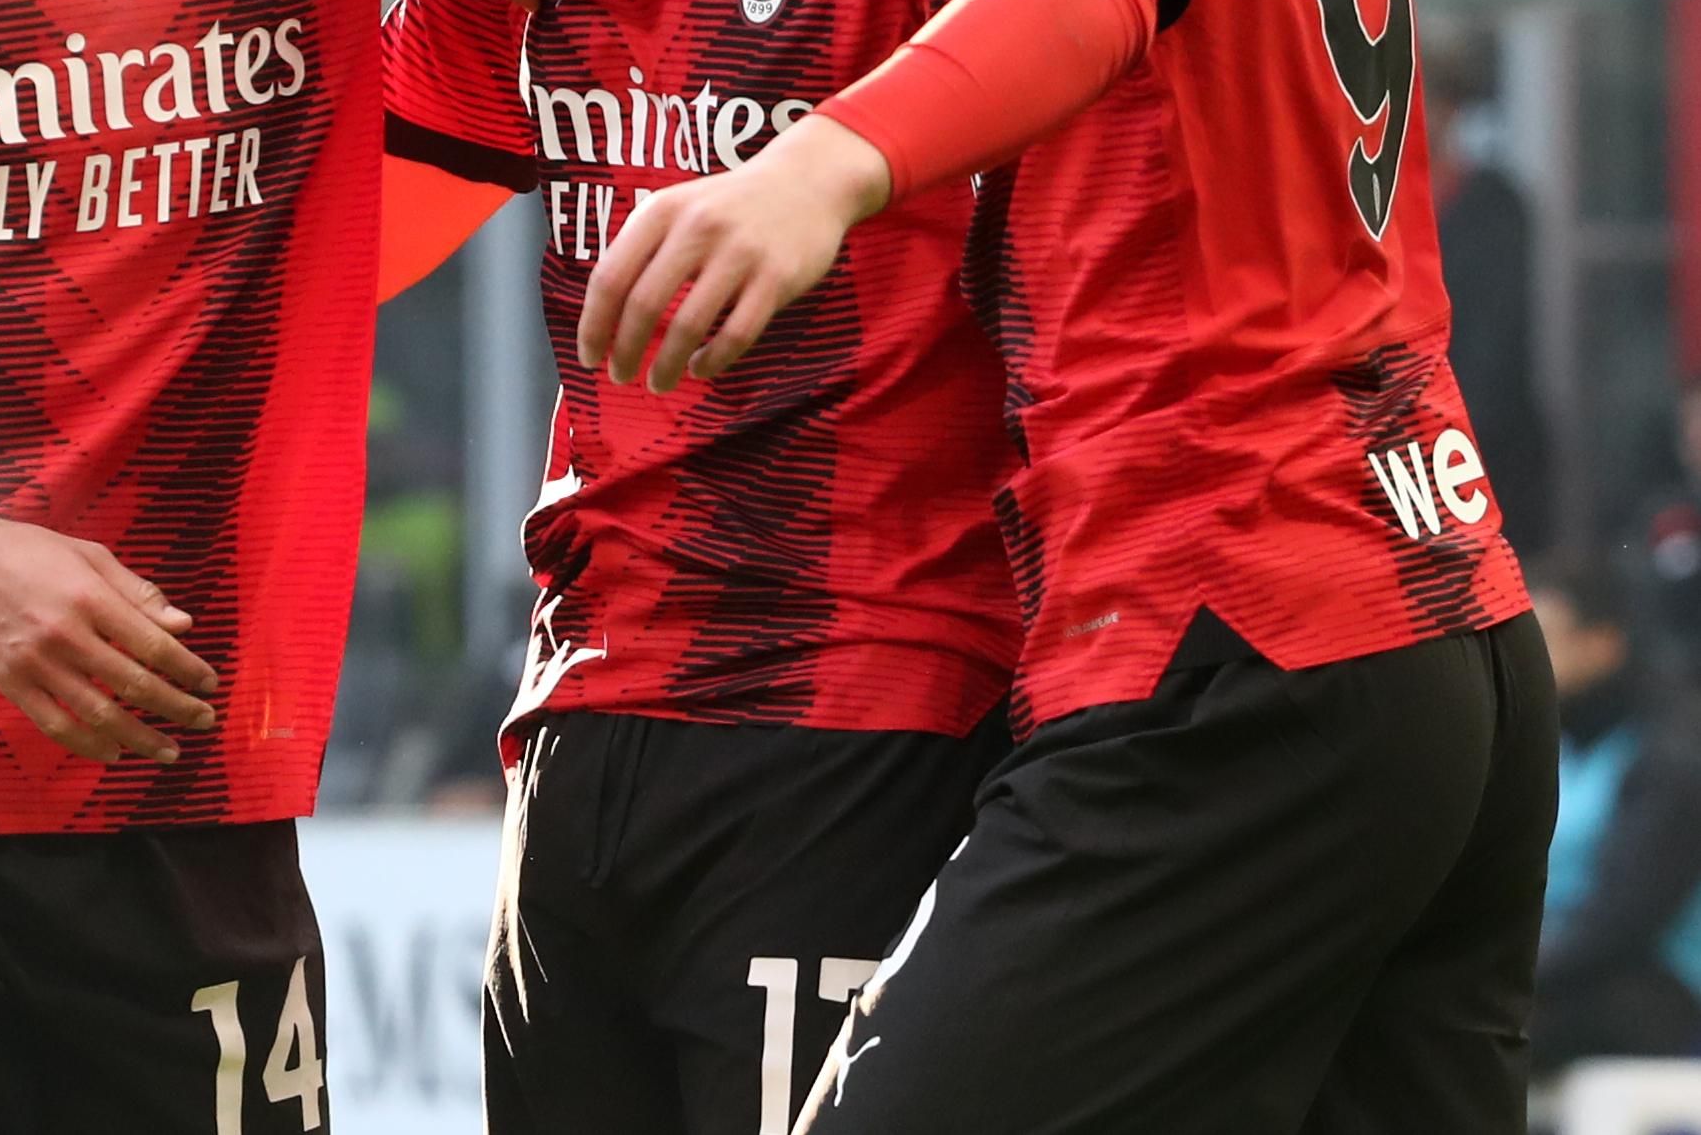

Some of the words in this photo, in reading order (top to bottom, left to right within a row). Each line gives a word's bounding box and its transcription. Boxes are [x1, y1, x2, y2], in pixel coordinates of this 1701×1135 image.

[746, 1, 773, 15] 1899
[75, 126, 264, 232] BETTER
[549, 180, 614, 261] FLY
[1367, 428, 1489, 540] we
[190, 954, 325, 1135] 14
